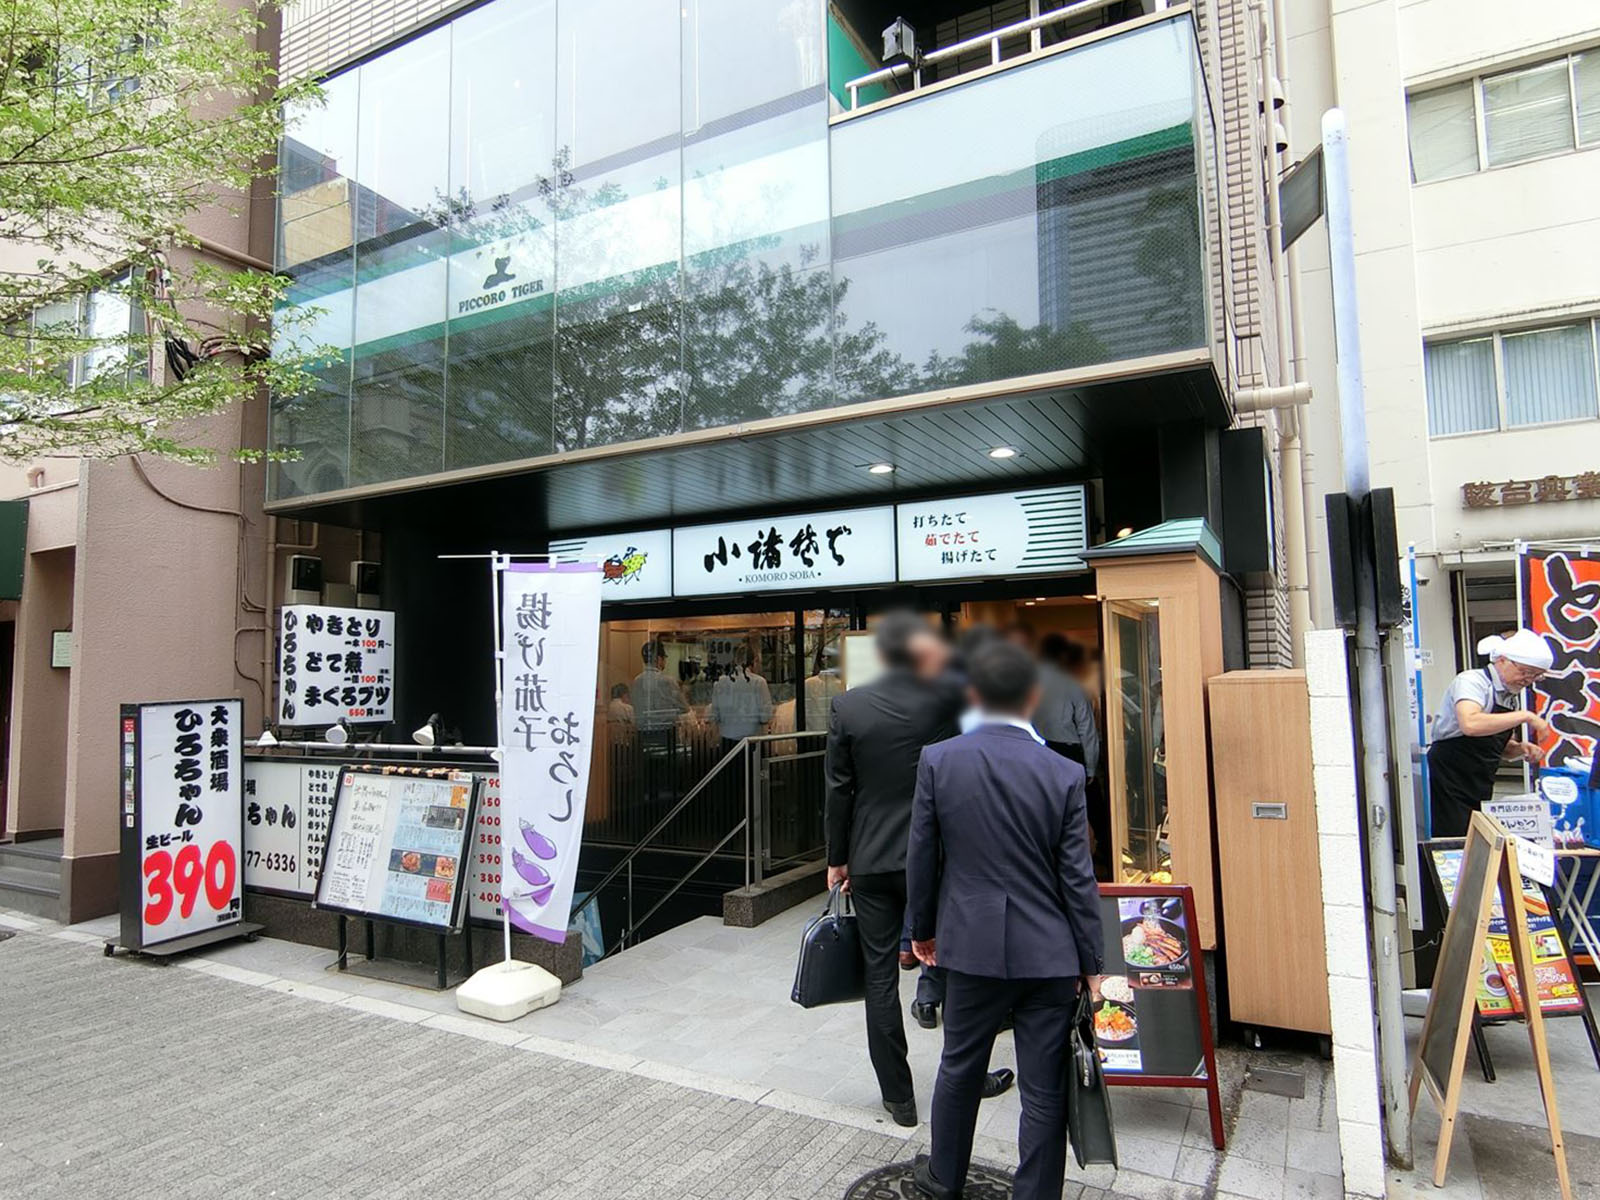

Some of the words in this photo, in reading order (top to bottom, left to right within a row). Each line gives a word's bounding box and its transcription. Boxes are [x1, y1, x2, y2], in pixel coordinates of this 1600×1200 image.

[458, 290, 506, 313] PICCORO
[511, 279, 544, 298] TIGER
[913, 512, 967, 528] 打ちたて
[925, 531, 980, 546] 茹でたて
[941, 548, 997, 565] 揚げたて
[745, 572, 788, 584] KOMORO
[789, 570, 816, 580] SOBA
[306, 613, 381, 637] やきとり
[282, 610, 298, 719] ひろちゃん
[305, 651, 363, 674] どて煮
[304, 686, 390, 707] まぐろブツ
[210, 705, 229, 792] 大衆酒場
[174, 708, 203, 828] ひろちゃん
[247, 802, 297, 829] ちゃん
[478, 815, 501, 826] 400
[146, 830, 194, 850] 生ビール
[479, 834, 501, 845] 350
[246, 850, 296, 873] 77-6336
[479, 853, 501, 865] 390
[143, 840, 237, 926] 390
[479, 873, 501, 884] 380
[479, 892, 501, 903] 400
